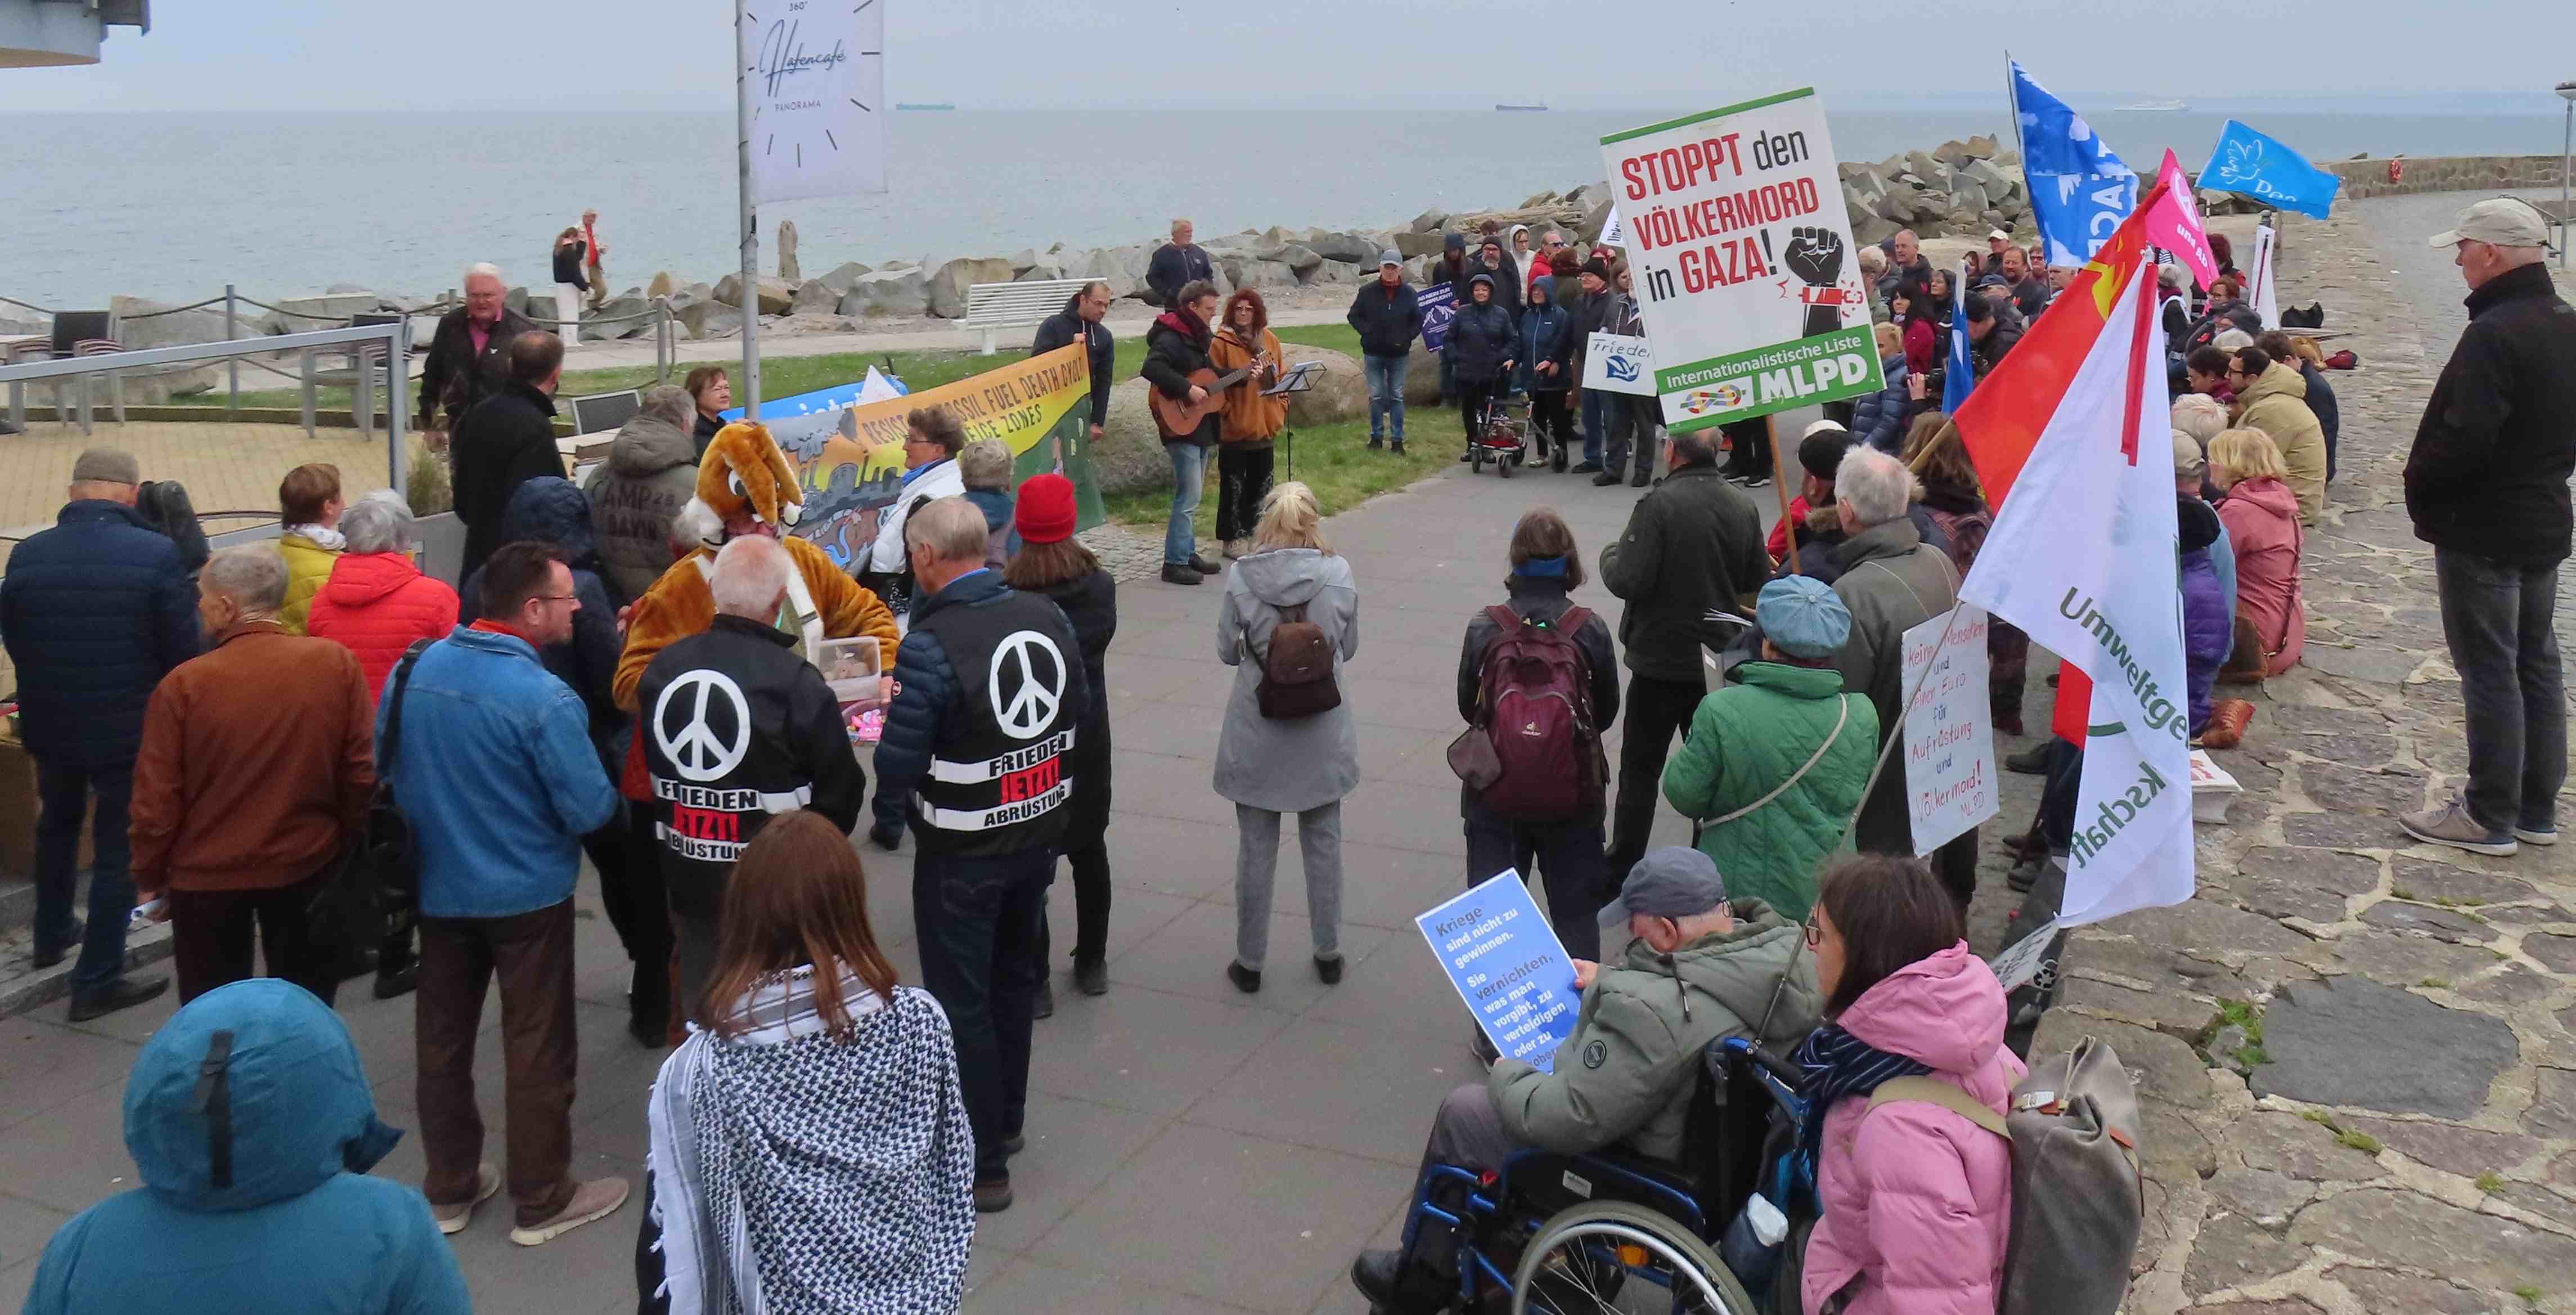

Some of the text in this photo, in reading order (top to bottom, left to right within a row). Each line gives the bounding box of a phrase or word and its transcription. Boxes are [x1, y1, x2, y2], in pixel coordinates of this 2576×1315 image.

[775, 100, 821, 111] PANORAMA
[1621, 130, 1809, 200] STOPPT den
[1633, 177, 1819, 251] VÖLKERMORD
[1646, 228, 1777, 302] in GAZA!
[1666, 335, 1862, 389] Internationalistische Liste
[1759, 353, 1868, 405] MLPD
[983, 382, 1021, 412] FUEL
[1018, 367, 1060, 400] DEATH
[999, 403, 1042, 433] ZONES
[1934, 655, 1949, 675] und
[1942, 673, 1966, 696] Euro
[2060, 586, 2189, 749] Umweltge
[1933, 703, 1947, 726] für
[990, 734, 1067, 777] FRIEDEN
[1912, 722, 1972, 765] Aufrüstung
[1936, 752, 1952, 774] und
[1435, 906, 1483, 937] Kriege
[1445, 907, 1519, 953] sind nicht zu
[1454, 930, 1514, 970] gewinnen.
[1466, 971, 1487, 989] Sie
[1474, 953, 1554, 1001] vernichten,
[1483, 980, 1536, 1015] was man
[1492, 989, 1554, 1030] vorgibt, zu
[1503, 1001, 1567, 1044] verteidigen
[1513, 1030, 1553, 1058] oder zu
